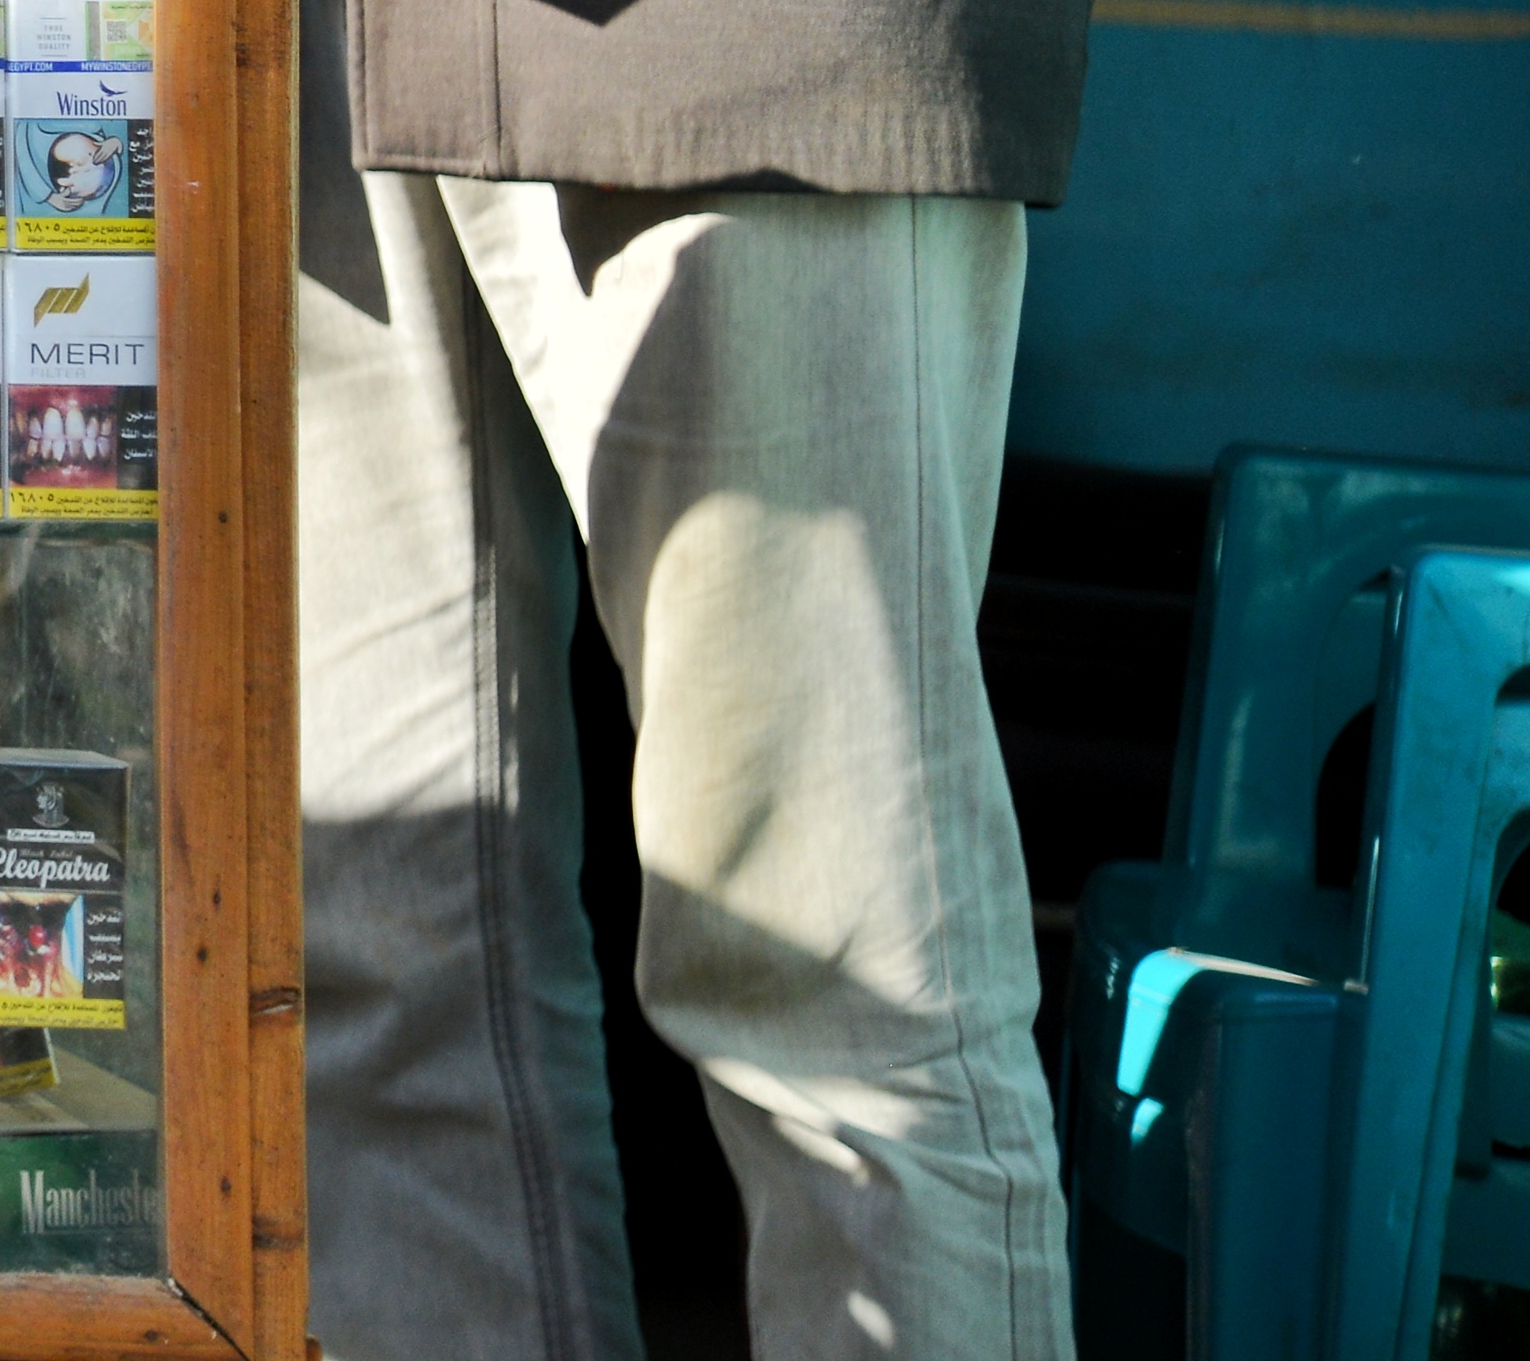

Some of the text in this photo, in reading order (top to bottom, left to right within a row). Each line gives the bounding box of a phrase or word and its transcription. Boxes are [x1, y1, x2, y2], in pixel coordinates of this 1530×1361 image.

[57, 91, 128, 117] Winston
[30, 342, 145, 366] MERIT
[20, 1168, 159, 1235] Mancheste
